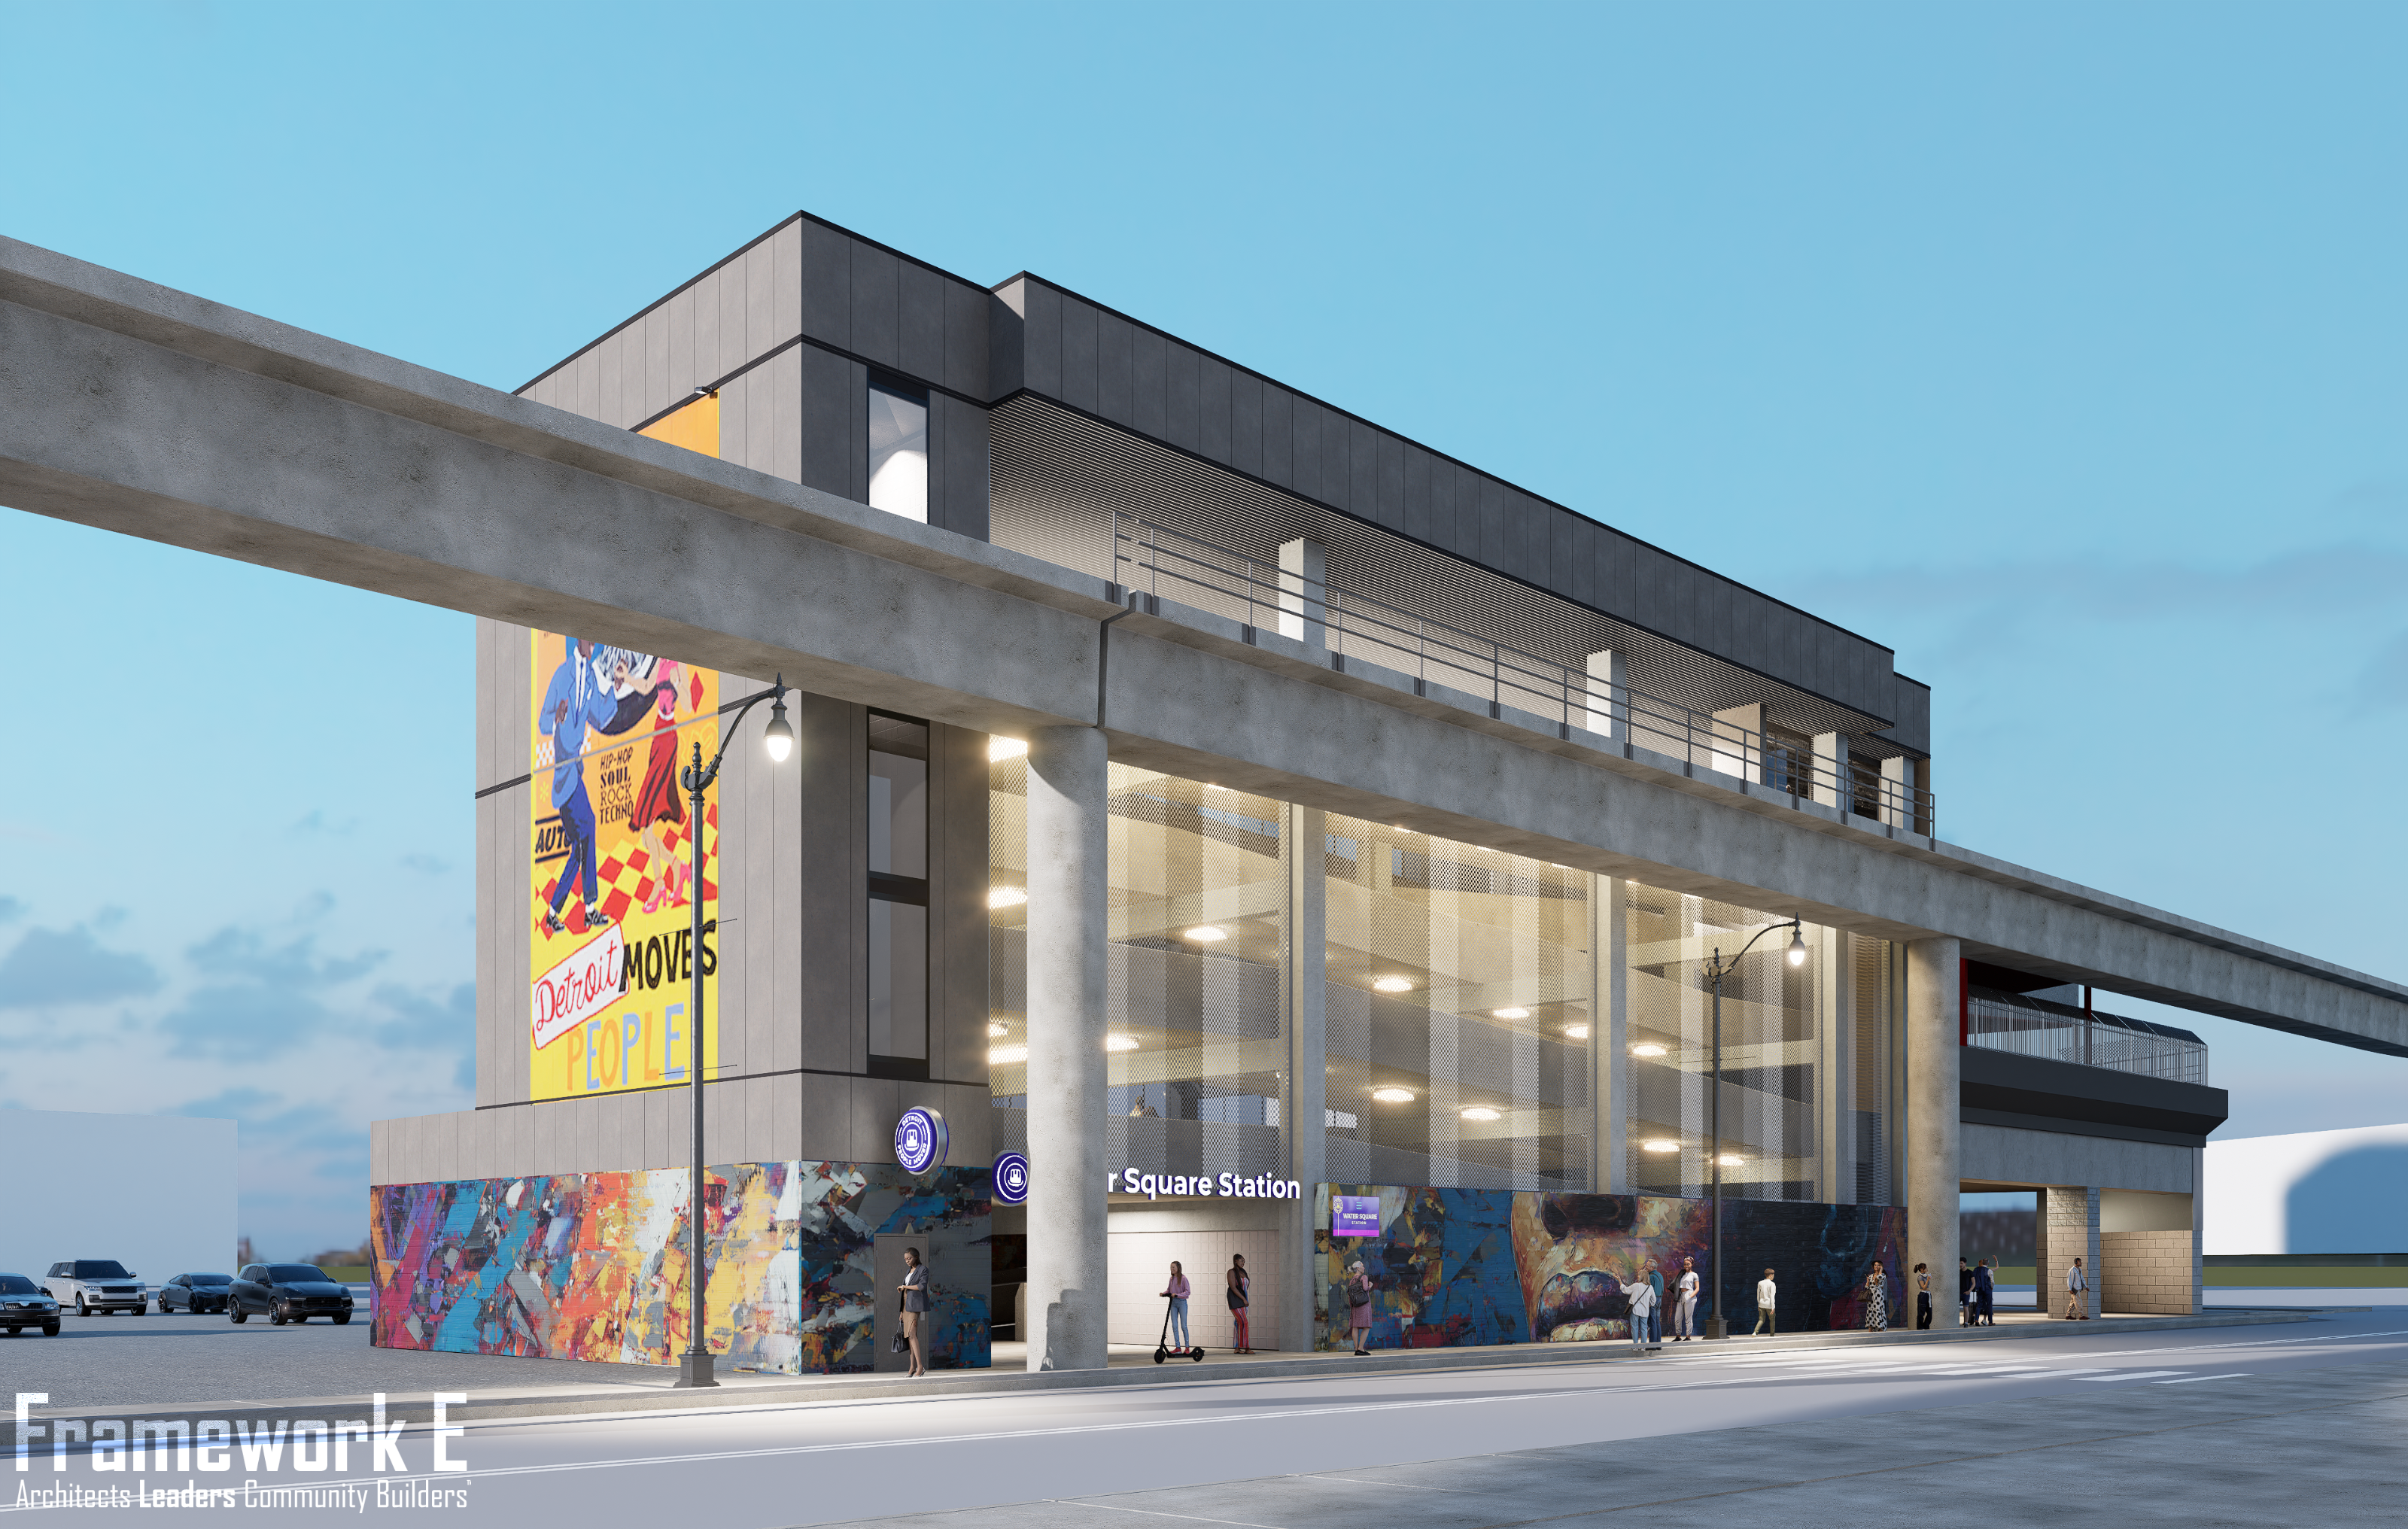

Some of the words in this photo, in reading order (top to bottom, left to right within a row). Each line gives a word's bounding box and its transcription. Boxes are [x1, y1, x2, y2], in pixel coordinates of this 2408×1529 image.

[600, 746, 634, 771] HIP-HOP
[600, 766, 631, 789] SOUL
[600, 783, 632, 807] ROCK
[600, 800, 634, 825] TECHNO
[535, 939, 618, 1031] Detroit
[567, 1002, 685, 1092] PEOPLE
[901, 1115, 923, 1126] DETROIT
[913, 1142, 927, 1165] MOVER
[1122, 1167, 1213, 1200] Square
[1217, 1172, 1300, 1199] Station
